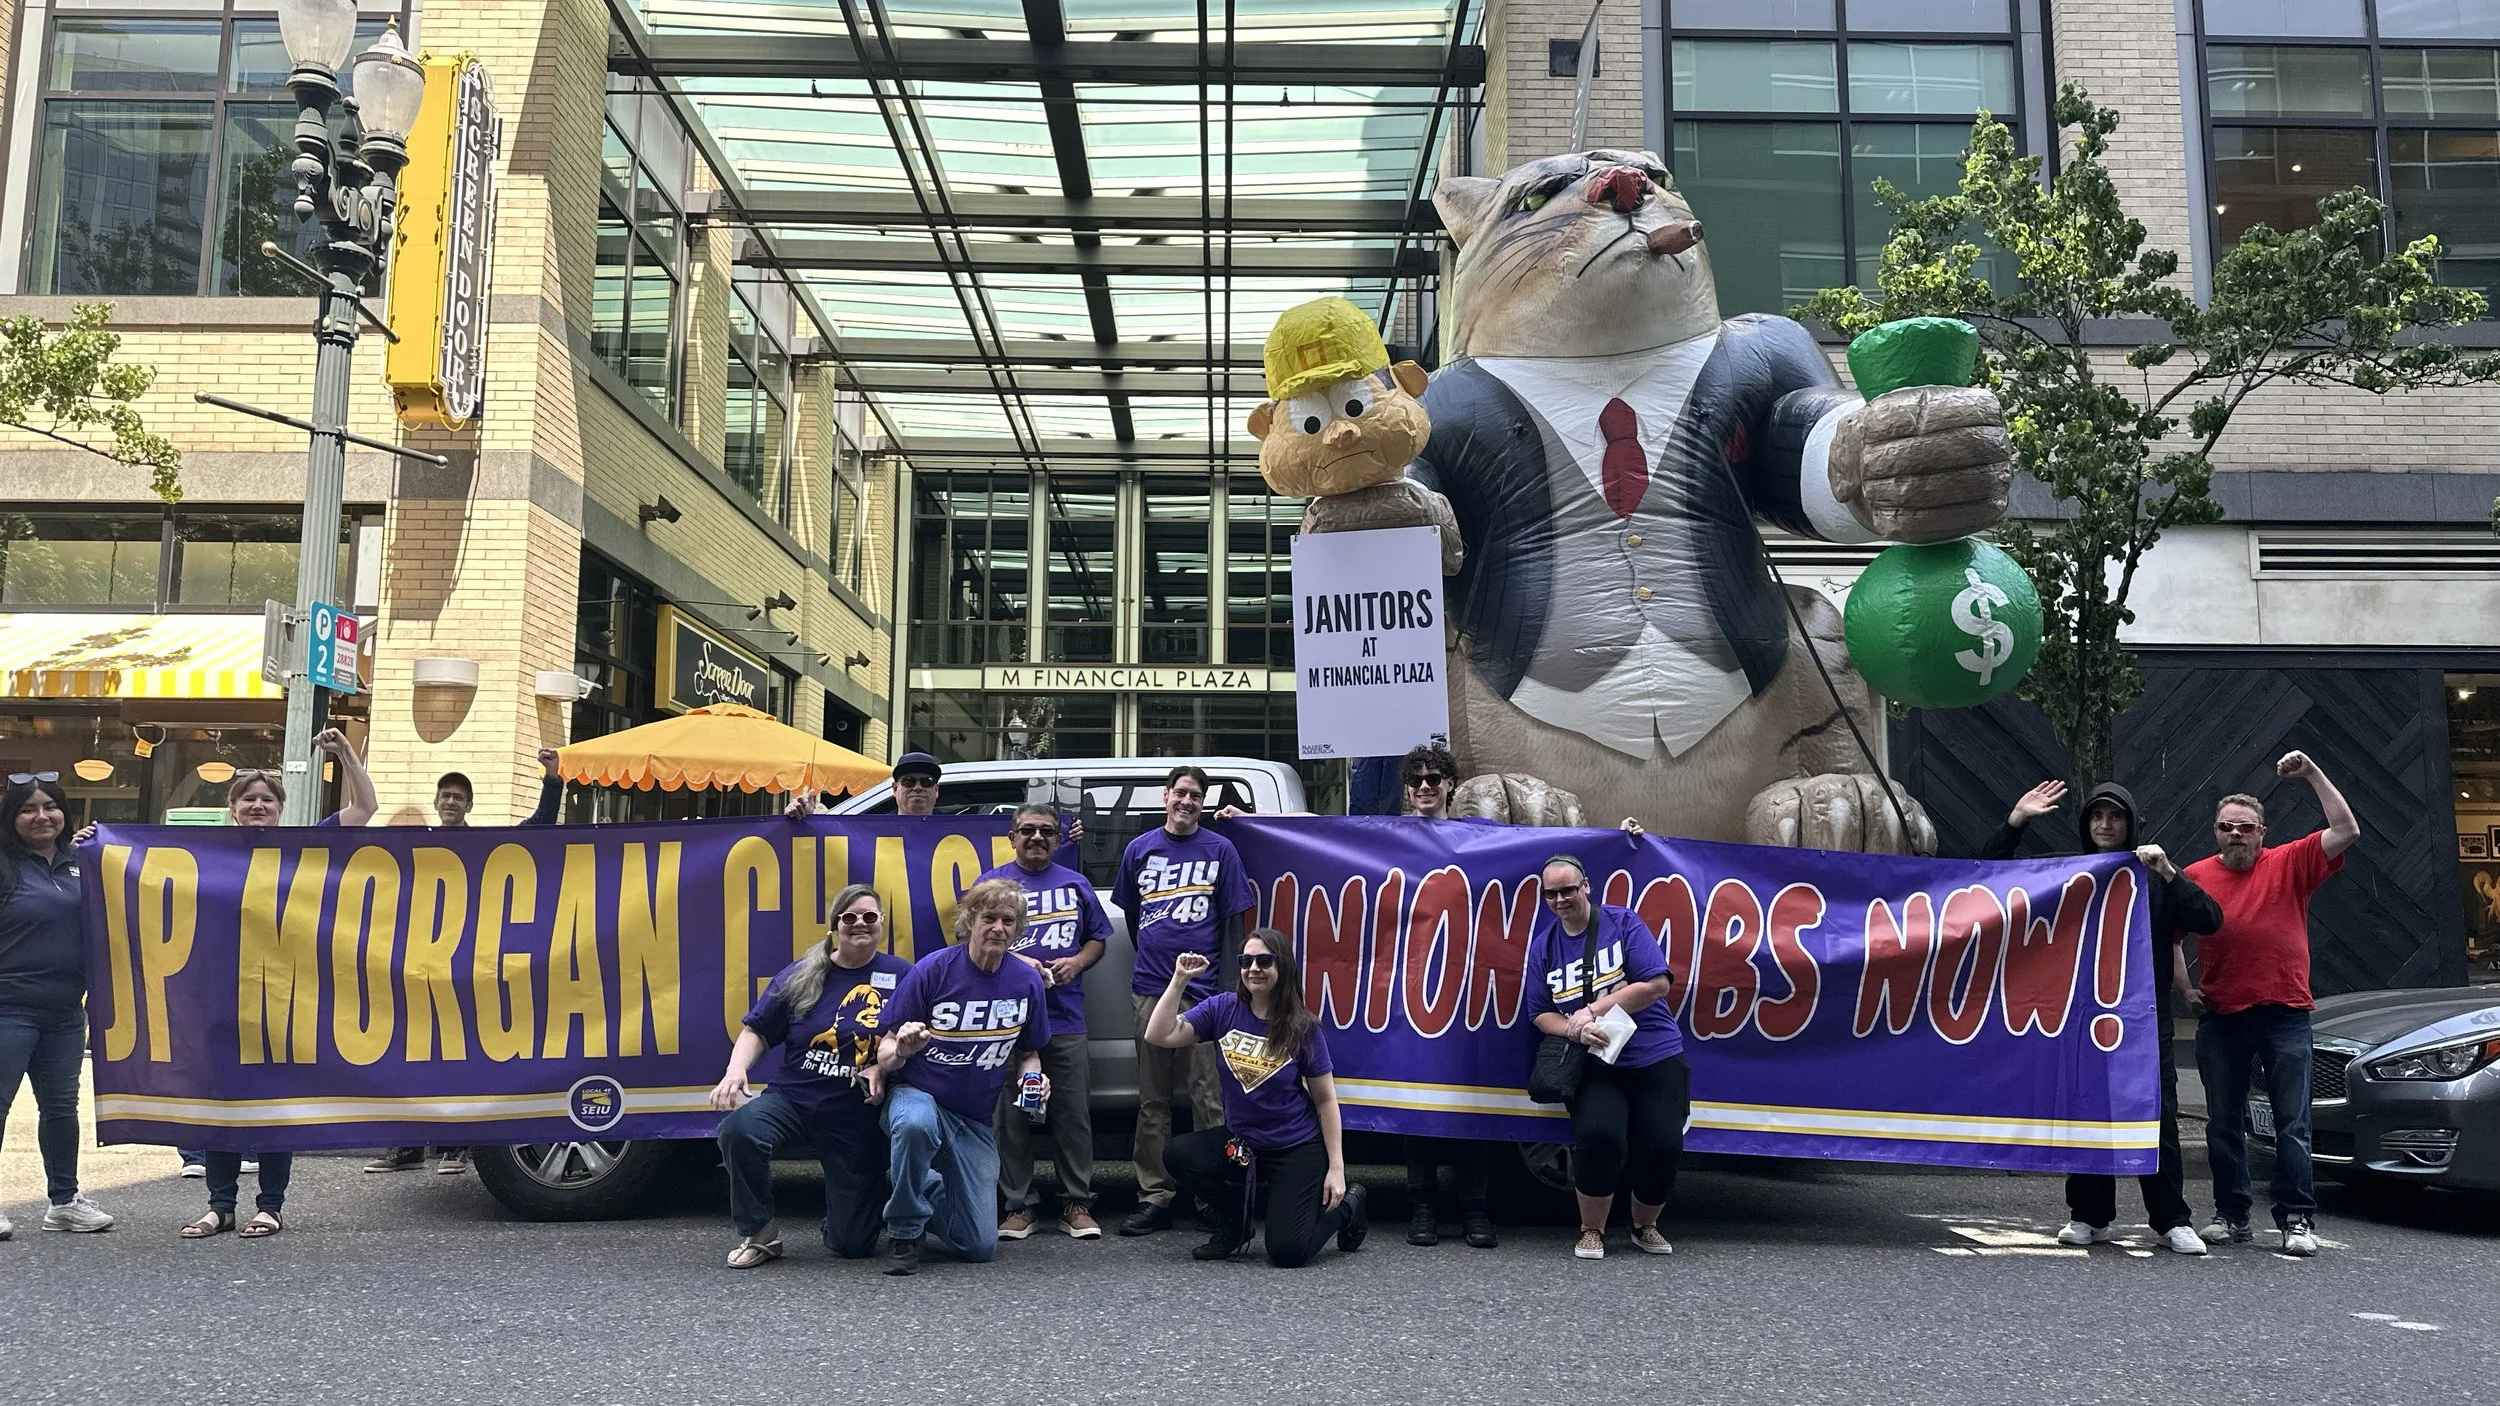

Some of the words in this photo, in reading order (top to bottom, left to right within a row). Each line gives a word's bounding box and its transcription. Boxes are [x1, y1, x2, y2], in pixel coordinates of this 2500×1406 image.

[459, 96, 482, 265] SCREEN
[453, 269, 472, 386] DOOR
[319, 613, 329, 636] P
[1304, 588, 1434, 635] JANITORS
[315, 644, 328, 675] 2
[1361, 636, 1378, 658] AT
[698, 641, 732, 692] Screen
[731, 666, 756, 700] Door
[1001, 669, 1021, 687] M
[1034, 669, 1164, 688] FINANCIAL
[1176, 670, 1253, 689] PLAZA
[1308, 667, 1320, 688] M
[1323, 664, 1391, 687] FINANCIAL
[1393, 662, 1434, 684] PLAZA
[1138, 860, 1220, 896] SEIU
[1022, 887, 1079, 917] EIU
[1171, 895, 1209, 923] 49
[100, 844, 199, 1063] JP
[238, 841, 682, 1066] MORGAN
[723, 834, 1014, 1048] CHAS
[1007, 927, 1039, 951] cal
[1040, 920, 1077, 950] 49
[1852, 866, 2137, 1052] NOW!
[930, 998, 1029, 1031] SEIU
[801, 1059, 818, 1071] for
[805, 1048, 840, 1065] SEIU
[924, 1044, 979, 1065] Local
[976, 1039, 1017, 1071] 49
[1227, 1053, 1259, 1066] Local
[1260, 1061, 1277, 1069] 49
[581, 1105, 611, 1115] SEIU
